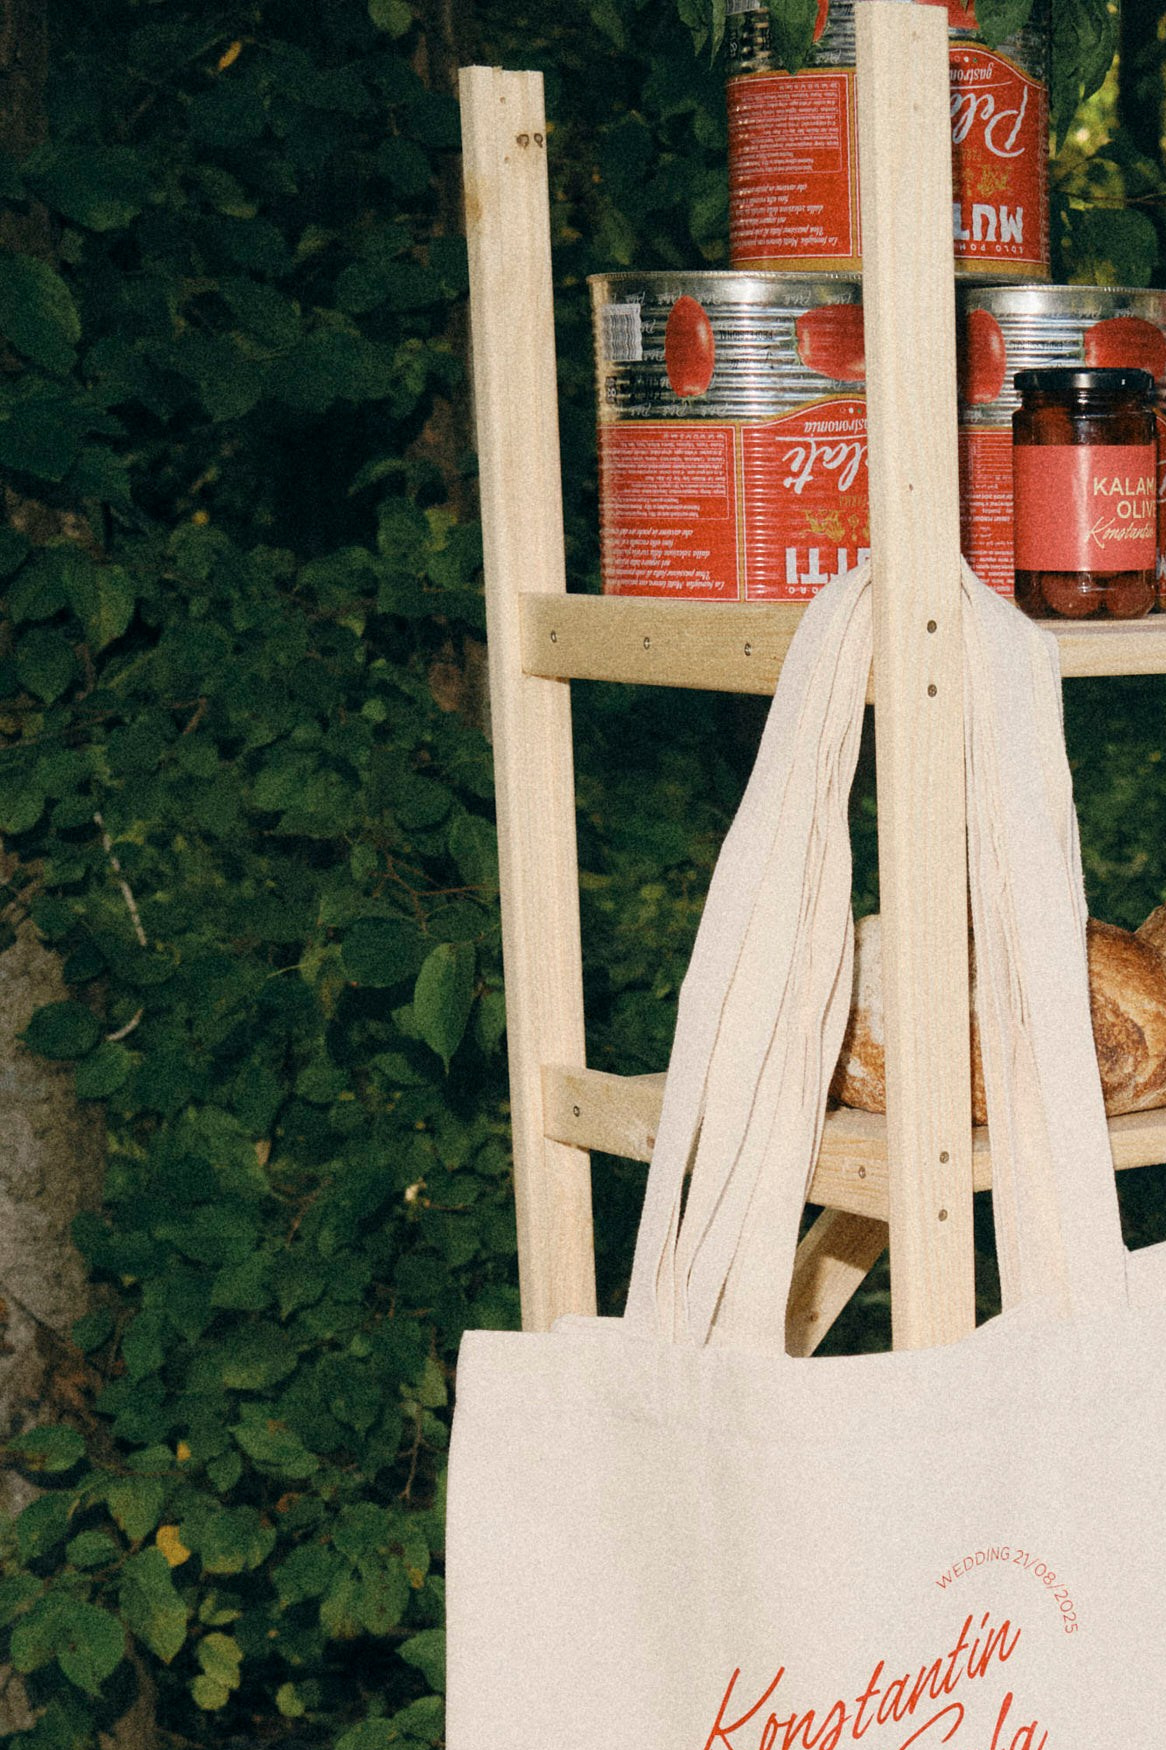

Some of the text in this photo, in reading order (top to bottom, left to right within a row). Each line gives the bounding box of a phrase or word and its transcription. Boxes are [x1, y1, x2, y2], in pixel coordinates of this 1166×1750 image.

[952, 204, 1025, 244] MUT
[1093, 477, 1155, 497] KALAM
[785, 547, 872, 586] TTI
[936, 1546, 1079, 1634] WEDDING 21/08/2025
